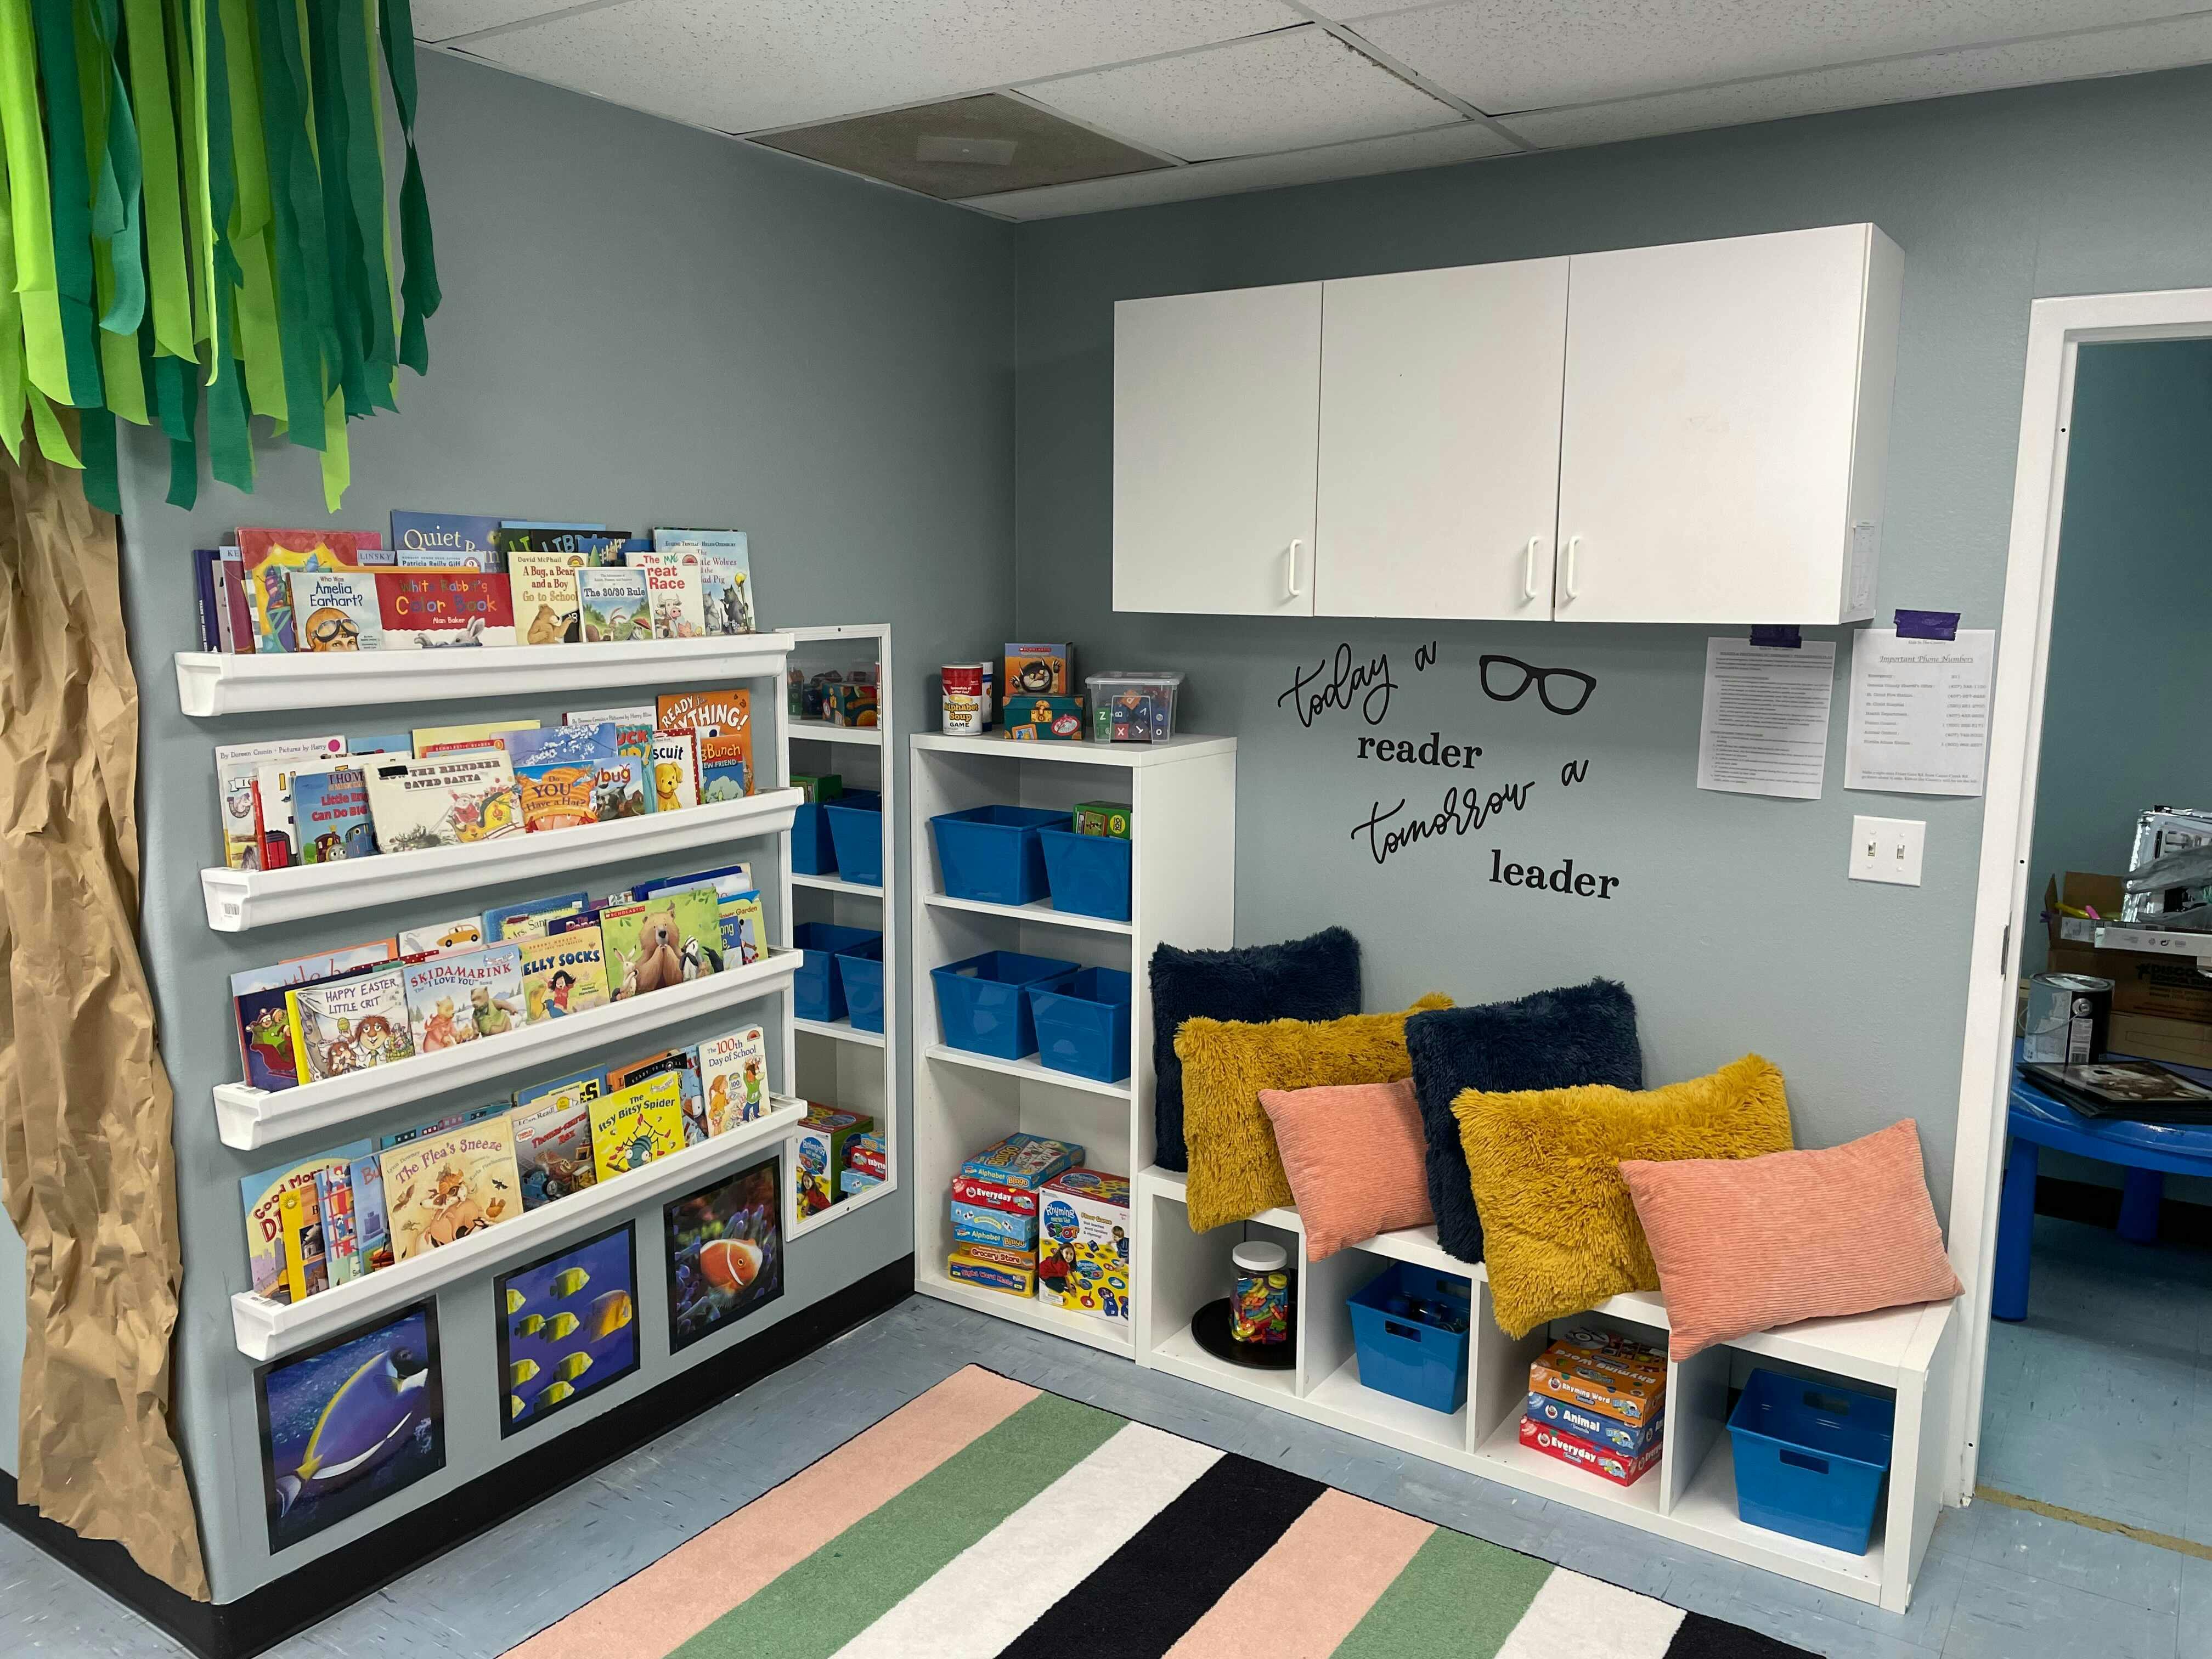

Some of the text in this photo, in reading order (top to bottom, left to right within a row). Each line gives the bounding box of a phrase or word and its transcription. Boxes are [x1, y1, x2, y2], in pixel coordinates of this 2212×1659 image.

[404, 526, 461, 551] Quiet
[644, 555, 659, 563] The
[713, 557, 737, 566] Wolves
[523, 566, 529, 575] A
[531, 566, 549, 578] Bug,
[556, 566, 575, 576] Bear,
[637, 563, 678, 577] reat
[400, 579, 488, 593] White Rabbit's
[532, 579, 545, 588] and
[554, 579, 568, 591] Boy
[649, 577, 685, 590] Race
[713, 575, 725, 584] Pig
[315, 582, 352, 595] Amelia
[523, 590, 578, 602] Go to School
[584, 587, 646, 597] The 30/30 Rule
[310, 594, 363, 607] Earhart?
[396, 595, 497, 615] Color Book
[1879, 656, 1915, 664] Important
[1942, 654, 1974, 663] Numbers
[1277, 640, 1437, 727] today a
[662, 695, 694, 729] READY
[943, 702, 979, 712] Alphabet
[949, 712, 972, 722] Soup
[617, 730, 648, 746] UCK
[311, 743, 326, 751] Harry
[653, 745, 684, 760] scuit
[1357, 732, 1483, 769] reader
[409, 760, 501, 777] THE REINDEER
[703, 759, 736, 769] EW FRIEND
[404, 774, 481, 789] SAVED SANTA
[594, 766, 631, 787] ybug
[532, 783, 571, 798] YOU
[526, 801, 550, 811] Have
[560, 797, 586, 806] Hat?
[1351, 759, 1589, 864] tomorrow a
[312, 810, 332, 821] Can
[333, 809, 348, 819] Do
[1489, 849, 1620, 900] leader
[610, 906, 645, 917] SCHOLASTIC
[736, 906, 758, 915] Garden
[523, 950, 601, 976] ELLY SOCKS
[410, 963, 512, 988] SKIDAMARINK
[434, 976, 455, 986] LOVE
[325, 978, 399, 1003] HAPPY EASTER,
[329, 1004, 358, 1014] LITTLE
[716, 1037, 743, 1054] 100th
[709, 1045, 757, 1068] Day of School
[730, 1079, 740, 1087] 100
[629, 1094, 644, 1104] The
[537, 1106, 555, 1119] Read!
[598, 1114, 616, 1133] Itsy
[618, 1101, 641, 1120] Bitsy
[643, 1098, 675, 1110] Spider
[395, 1163, 419, 1184] The
[420, 1142, 456, 1170] Flea's
[460, 1139, 502, 1153] Sneeze
[988, 1146, 1019, 1165] Bingo
[978, 1169, 1029, 1186] Alphabet Bingo
[253, 1184, 287, 1220] Good
[977, 1188, 1012, 1201] Everyday
[1046, 1204, 1075, 1218] Rhyming
[1046, 1222, 1080, 1238] SPOT
[972, 1231, 1026, 1247] Alphabet Bingo
[972, 1248, 1021, 1263] Grocery Store
[1562, 1383, 1611, 1404] Rhyming Word
[1563, 1410, 1600, 1433] Animal
[1551, 1435, 1596, 1463] Everyday
